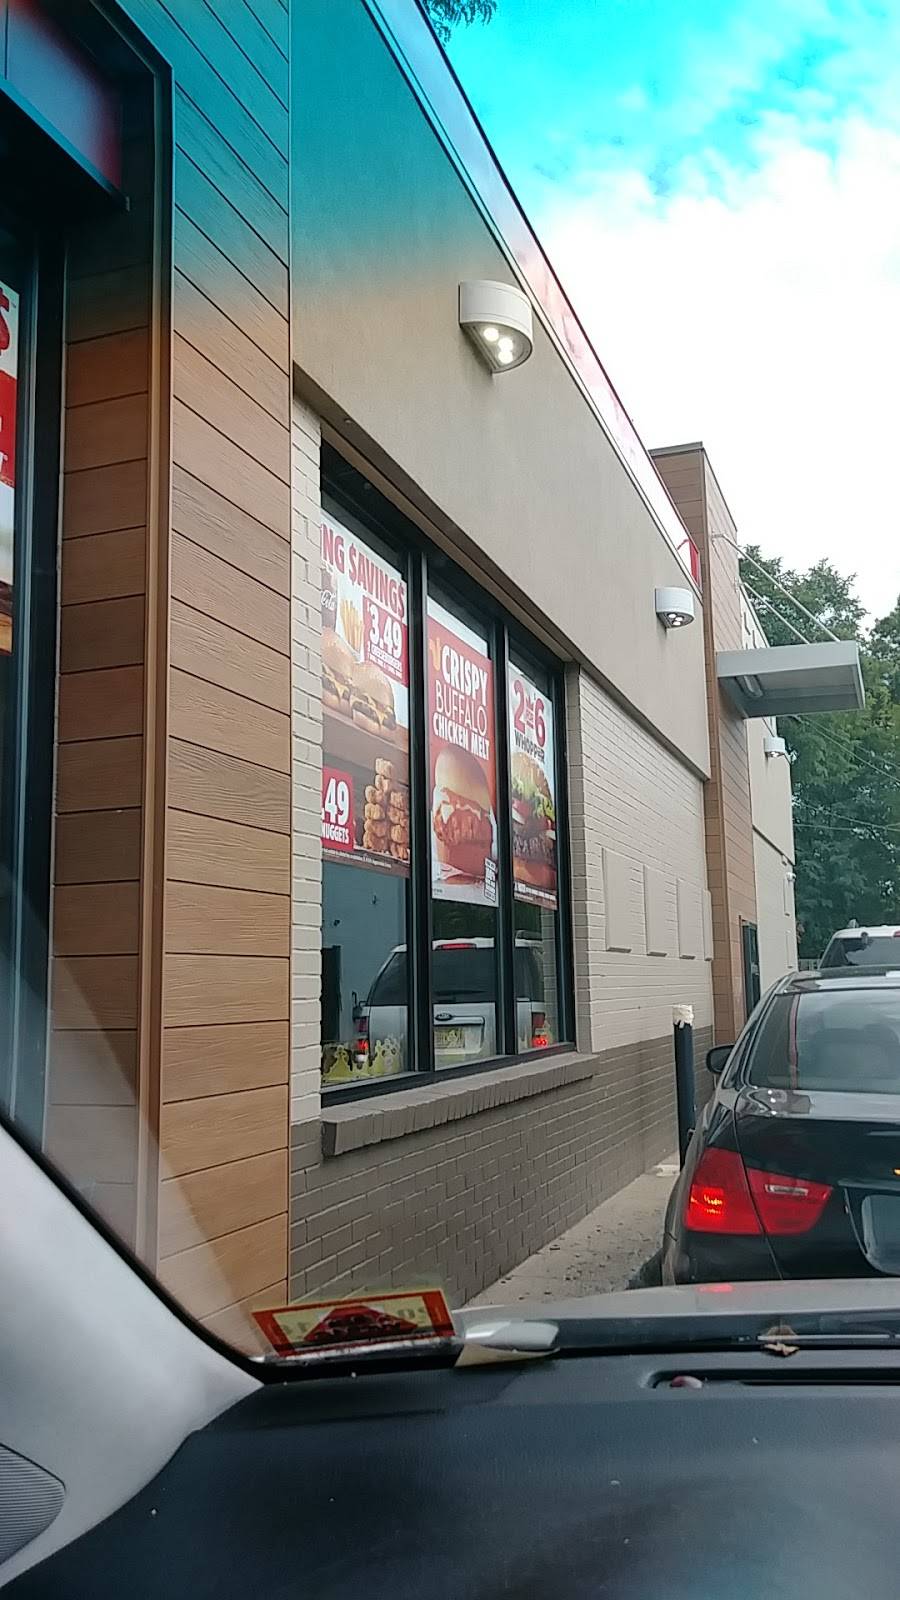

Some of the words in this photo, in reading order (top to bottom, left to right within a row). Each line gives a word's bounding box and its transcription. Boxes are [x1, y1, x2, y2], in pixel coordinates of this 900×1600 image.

[441, 644, 488, 707] CRISPY
[433, 712, 469, 751] CHICKEN
[471, 731, 490, 760] MELT
[435, 679, 488, 736] BUFFALO
[514, 680, 526, 735] 2
[535, 698, 546, 748] 6
[514, 729, 546, 764] WHOPPER
